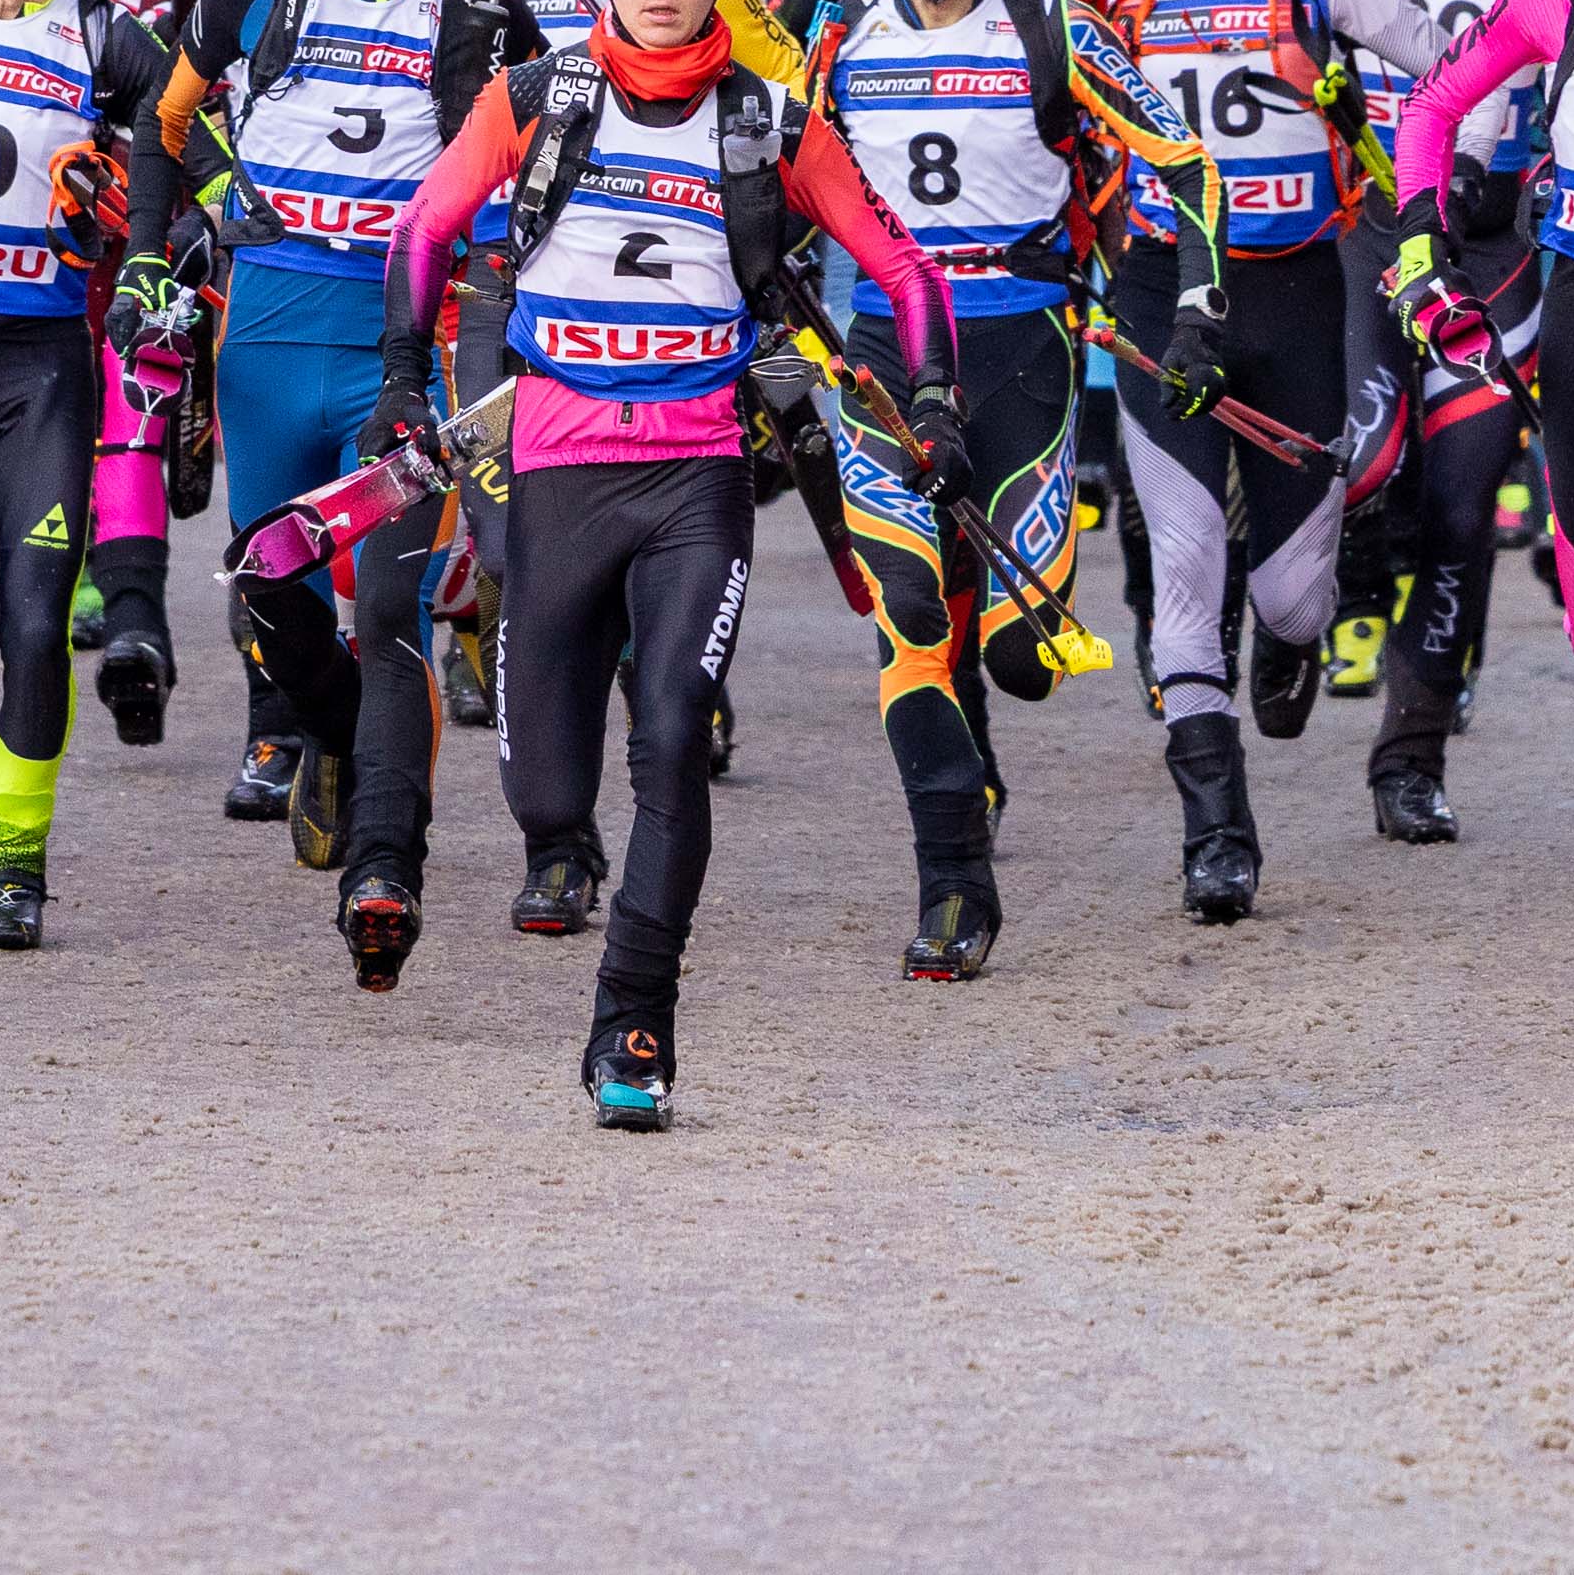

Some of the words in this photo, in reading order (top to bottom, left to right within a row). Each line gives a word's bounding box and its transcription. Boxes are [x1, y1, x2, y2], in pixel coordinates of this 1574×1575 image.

[1141, 15, 1209, 35] ountain
[294, 45, 362, 65] ountain
[850, 73, 932, 95] mountain
[935, 70, 1029, 95] attack
[1171, 66, 1265, 138] 16
[908, 131, 962, 206] 8
[545, 322, 739, 364] ISUZU
[698, 557, 749, 682] ATOMIC
